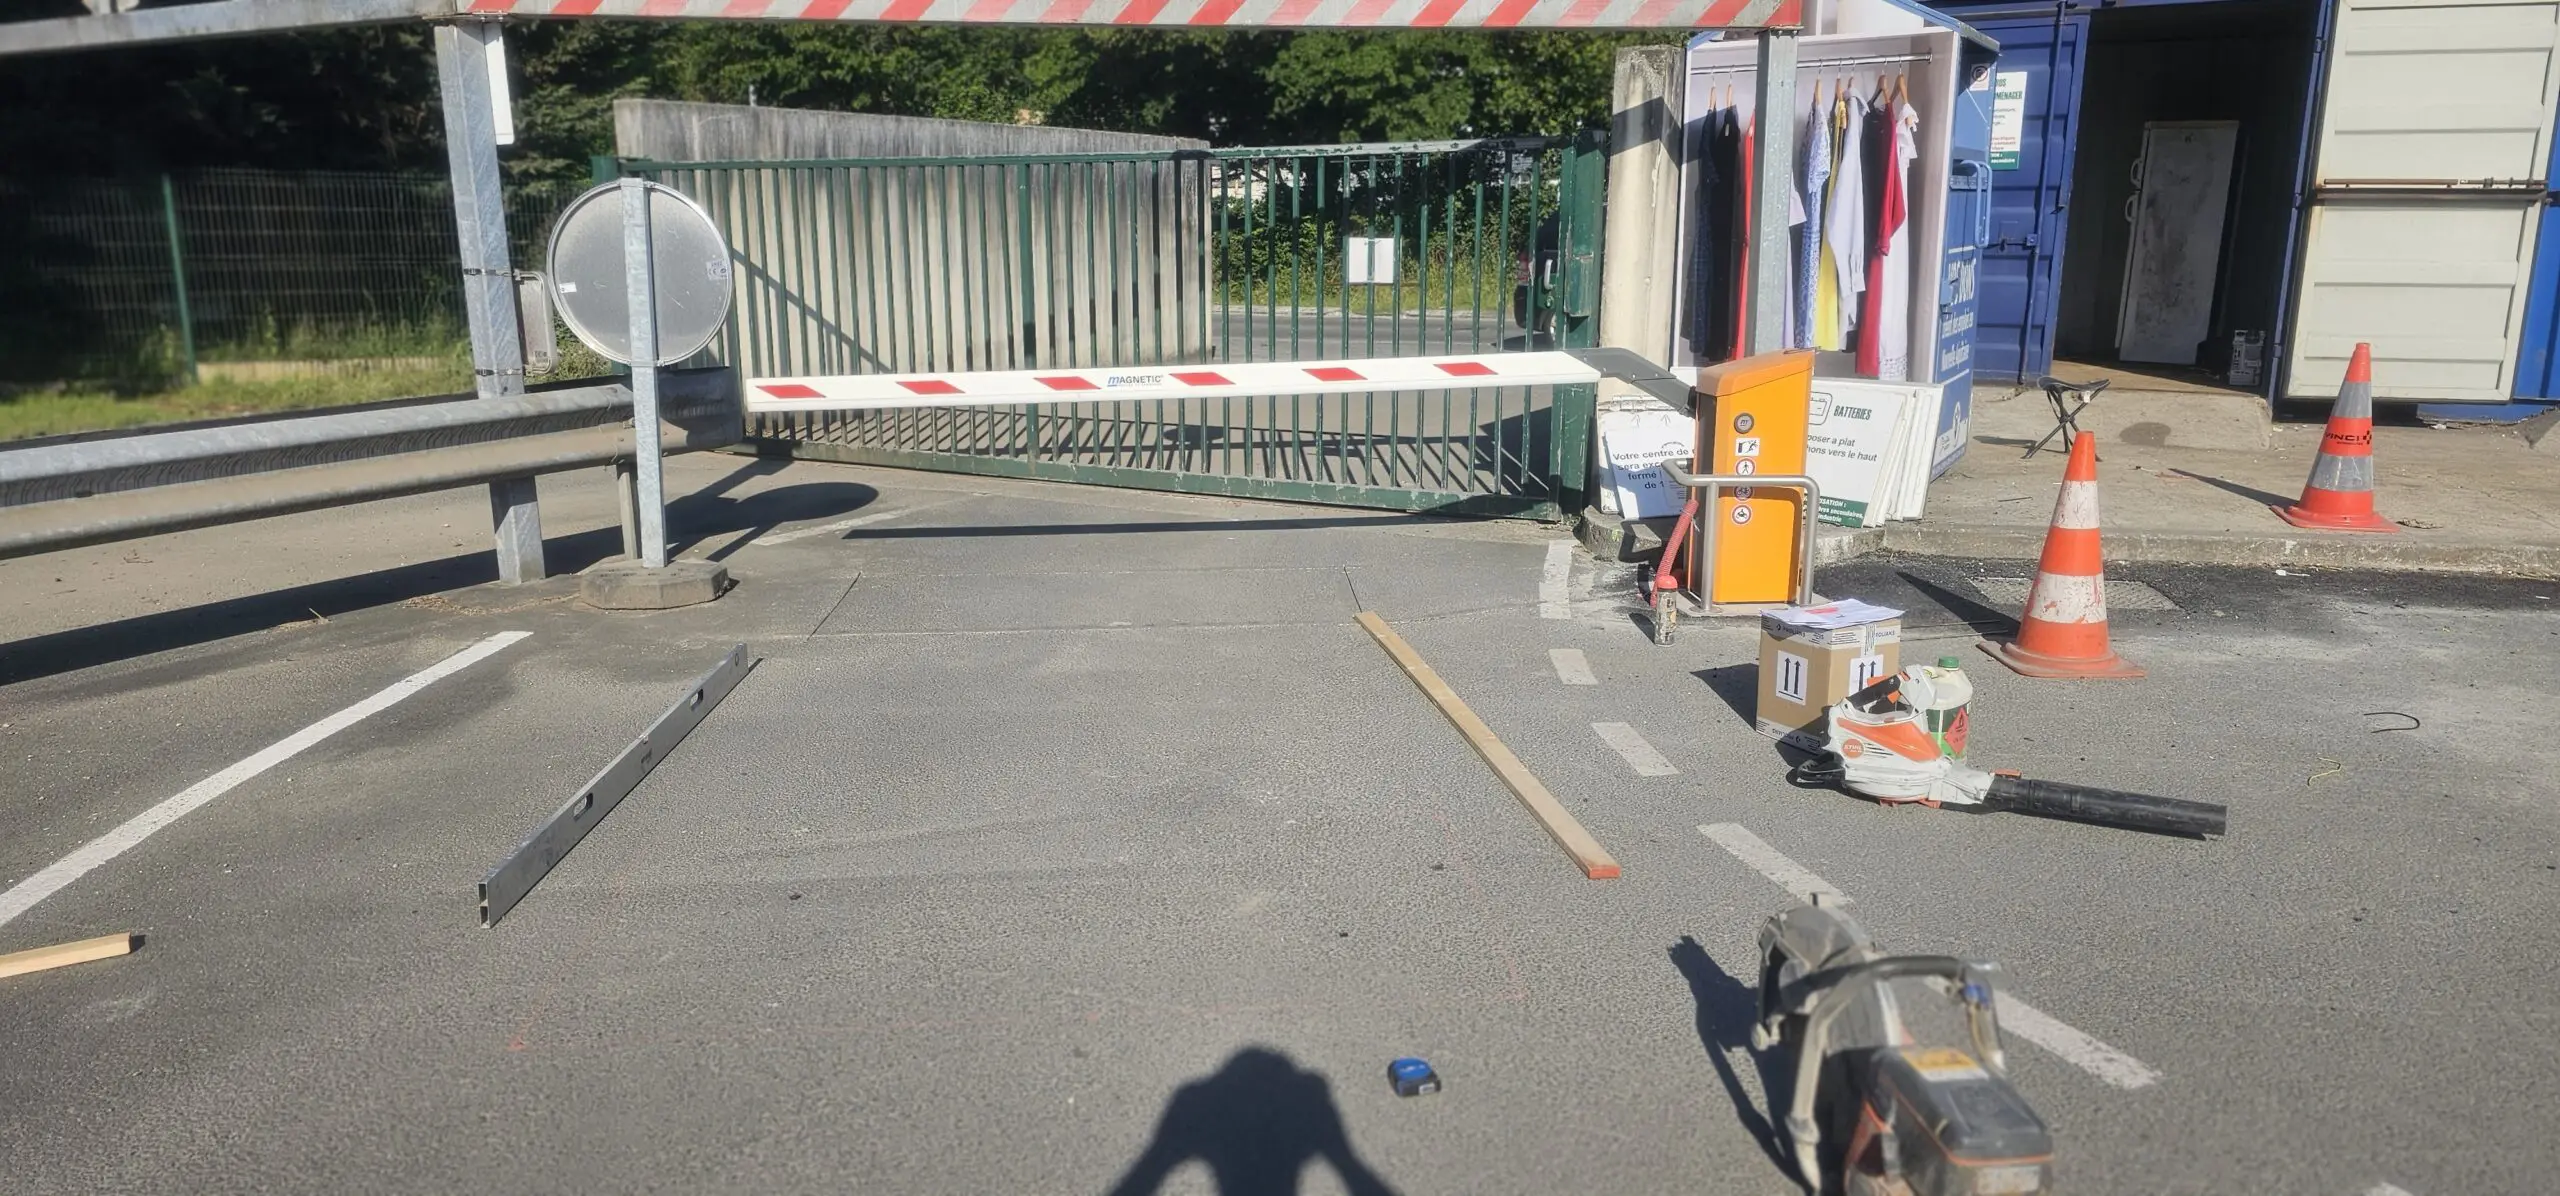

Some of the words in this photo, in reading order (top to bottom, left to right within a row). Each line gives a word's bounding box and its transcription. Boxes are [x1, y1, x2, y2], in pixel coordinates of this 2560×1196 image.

[1834, 405, 1872, 420] BATTERIES
[1807, 434, 1831, 443] poser
[1838, 437, 1856, 447] plat
[2325, 433, 2360, 441] VINCI
[1613, 453, 1639, 461] Votre
[1642, 449, 1674, 458] centre
[1676, 448, 1689, 456] de
[1828, 448, 1846, 458] vers
[1848, 449, 1856, 459] le
[1857, 452, 1878, 462] haut
[1617, 463, 1640, 471] sera
[1628, 471, 1657, 480] fermé
[1644, 481, 1657, 489] de
